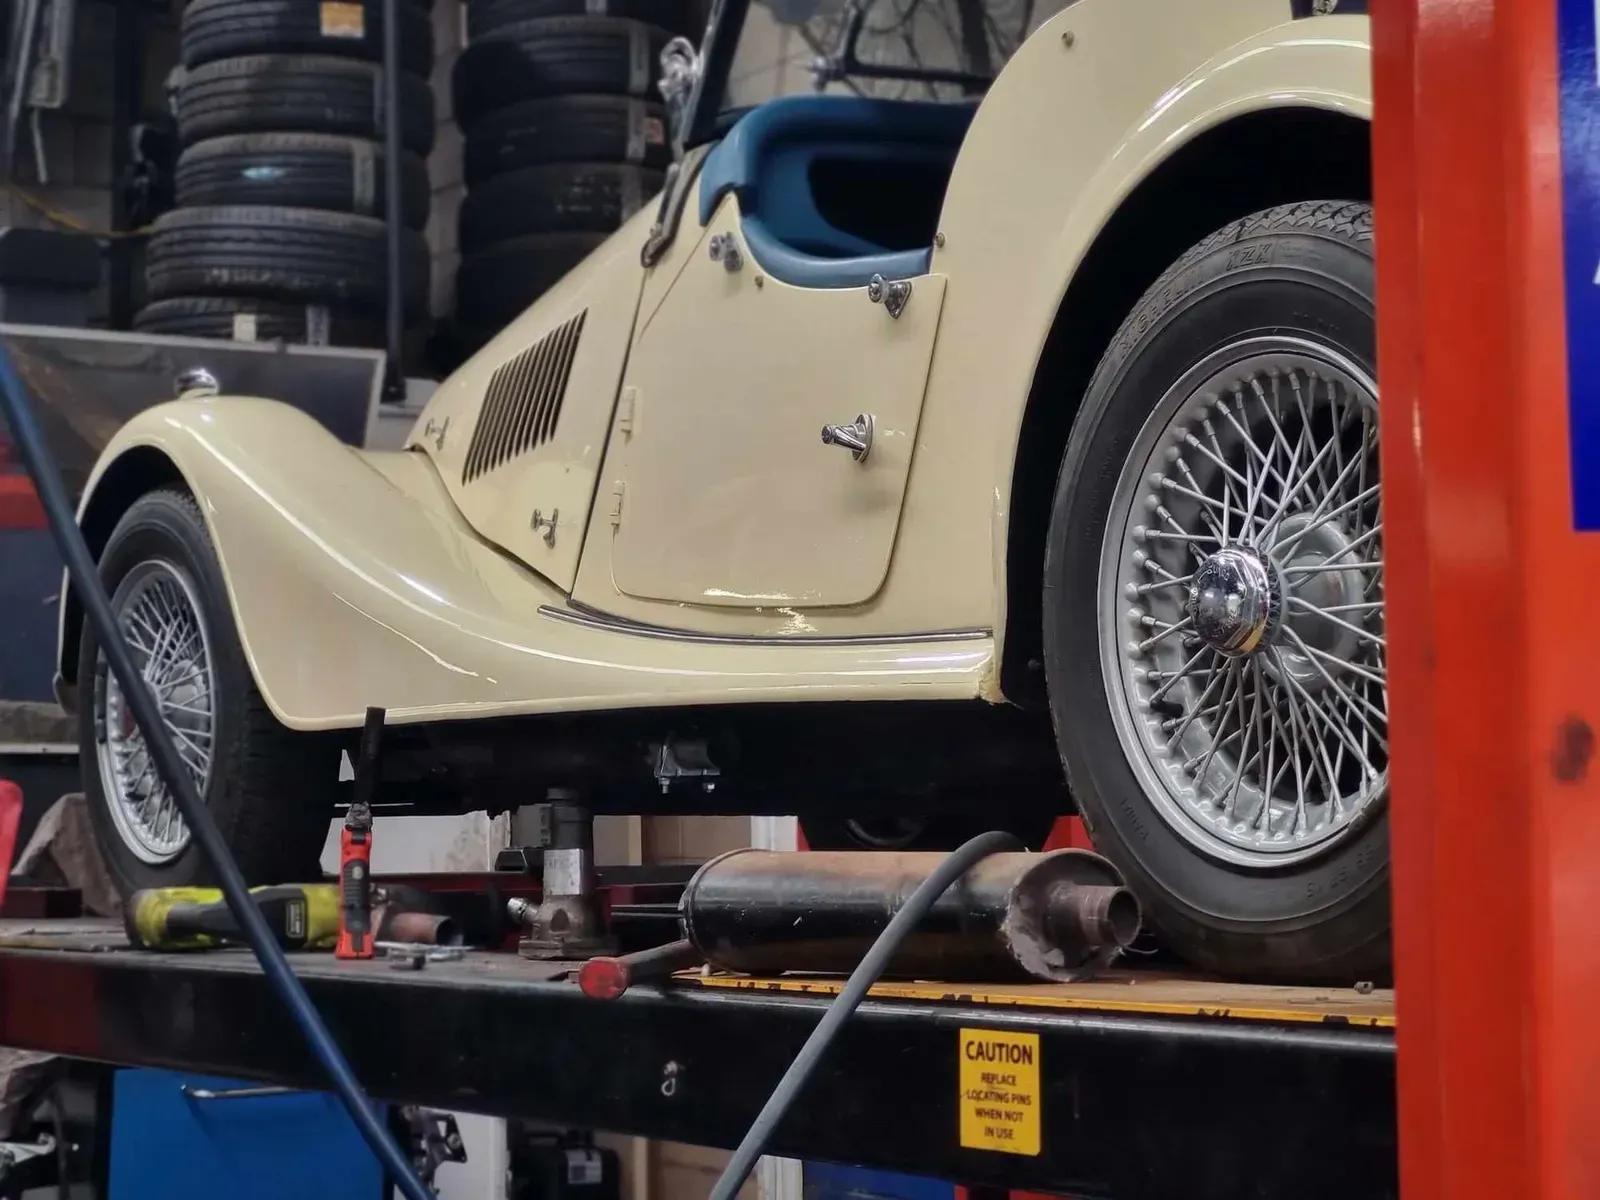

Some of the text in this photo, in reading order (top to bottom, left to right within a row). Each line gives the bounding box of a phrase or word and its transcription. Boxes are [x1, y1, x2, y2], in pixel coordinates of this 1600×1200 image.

[966, 1041, 1033, 1065] CAUTION
[981, 1072, 1016, 1086] REPLACE
[966, 1089, 1032, 1106] LOCATING PINS
[975, 1106, 1024, 1122] WHEN NOT
[984, 1126, 1014, 1140] IN USE
